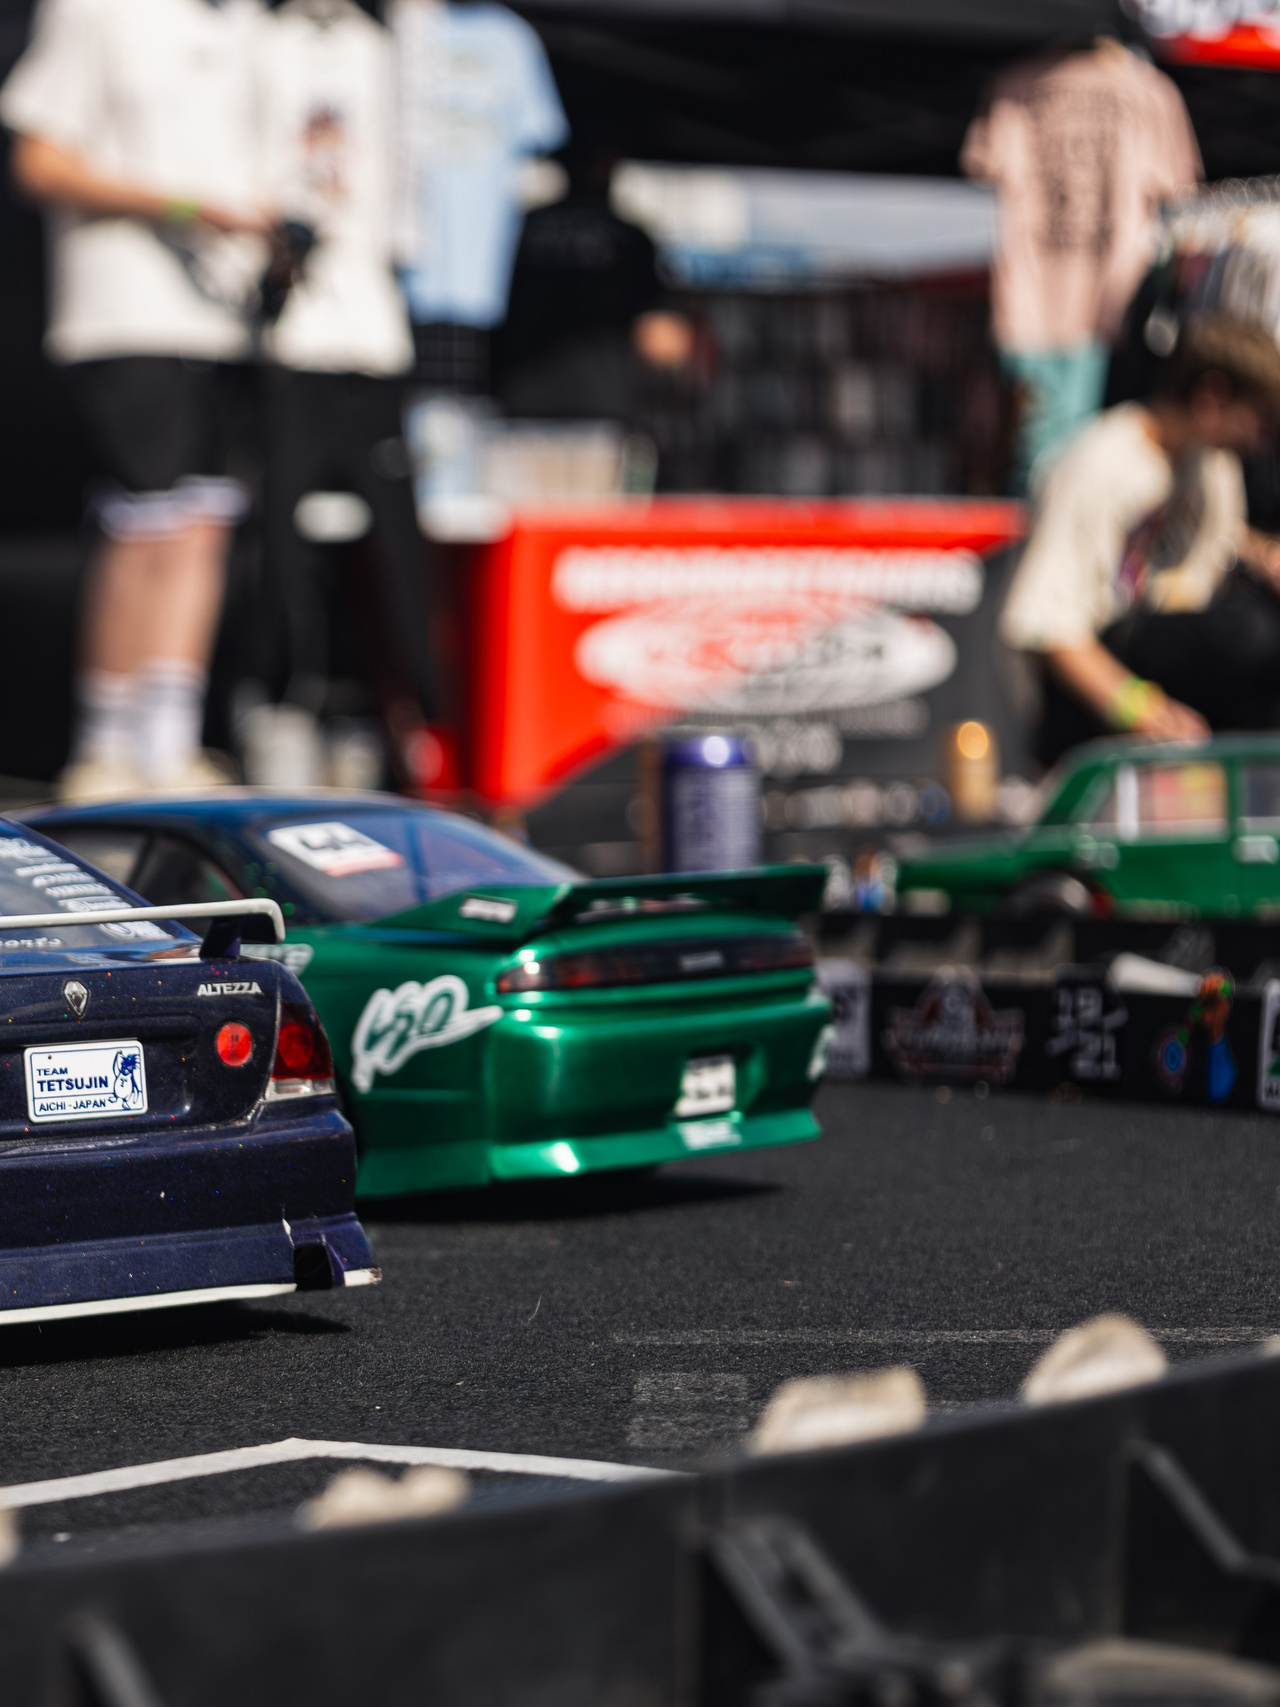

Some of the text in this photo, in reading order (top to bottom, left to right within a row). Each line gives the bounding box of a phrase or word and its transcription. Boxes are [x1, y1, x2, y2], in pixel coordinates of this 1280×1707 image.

[196, 981, 263, 997] ALTEZZA
[36, 1067, 68, 1076] TEAM
[37, 1076, 108, 1092] TETSUJIN
